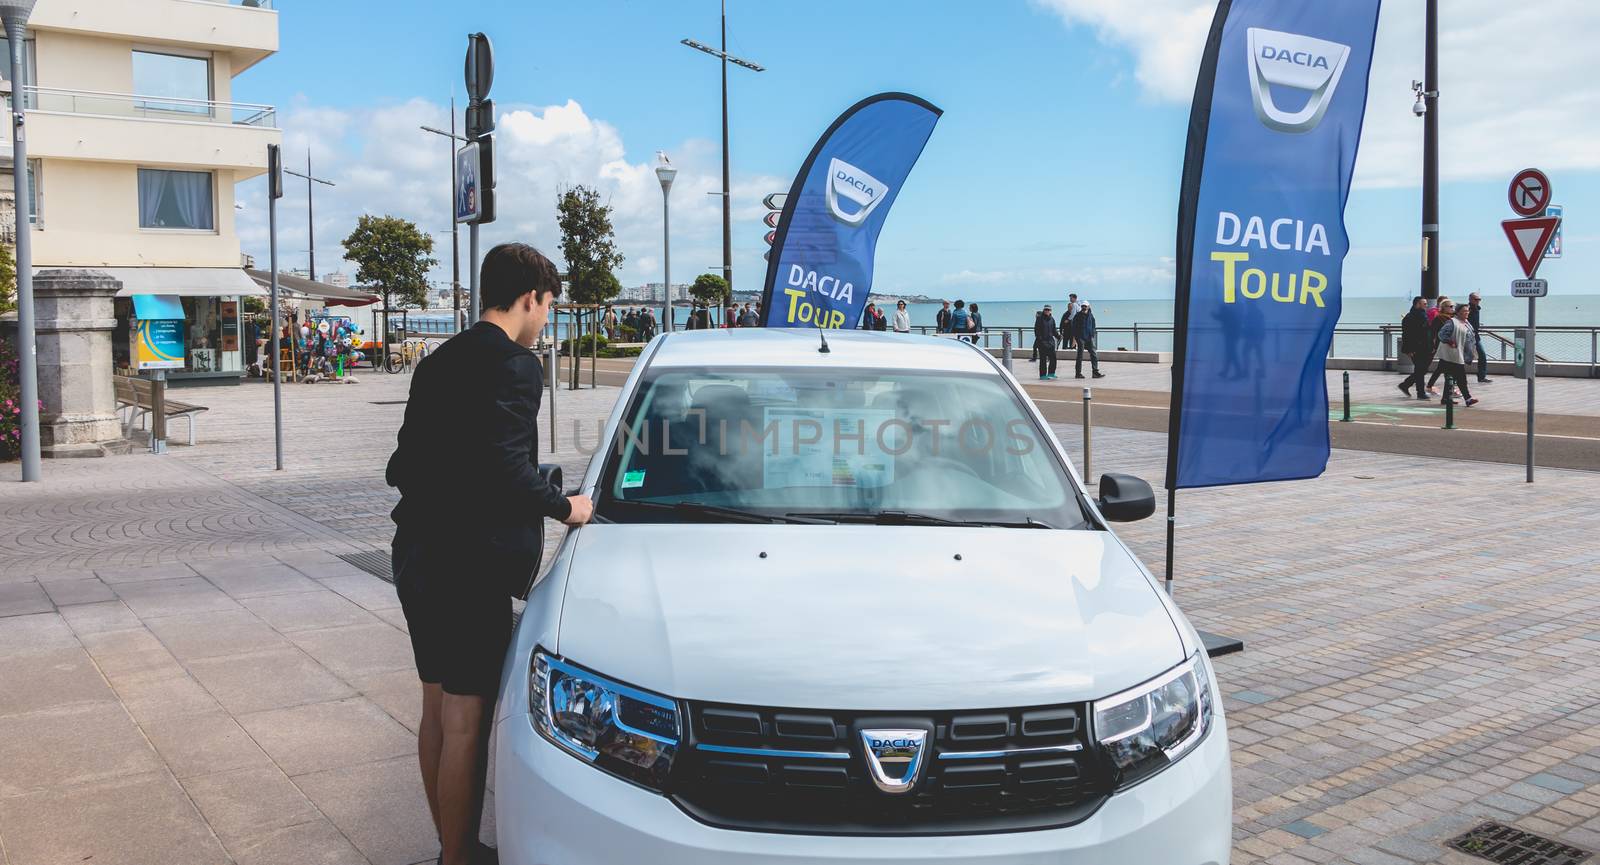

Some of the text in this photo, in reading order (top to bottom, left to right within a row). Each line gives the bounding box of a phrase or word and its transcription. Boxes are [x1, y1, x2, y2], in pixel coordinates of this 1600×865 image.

[1261, 46, 1329, 70] DACIA
[836, 171, 874, 198] DACIA
[1215, 211, 1330, 256] DACIA
[788, 264, 853, 304] DACIA
[872, 739, 917, 748] DACIA
